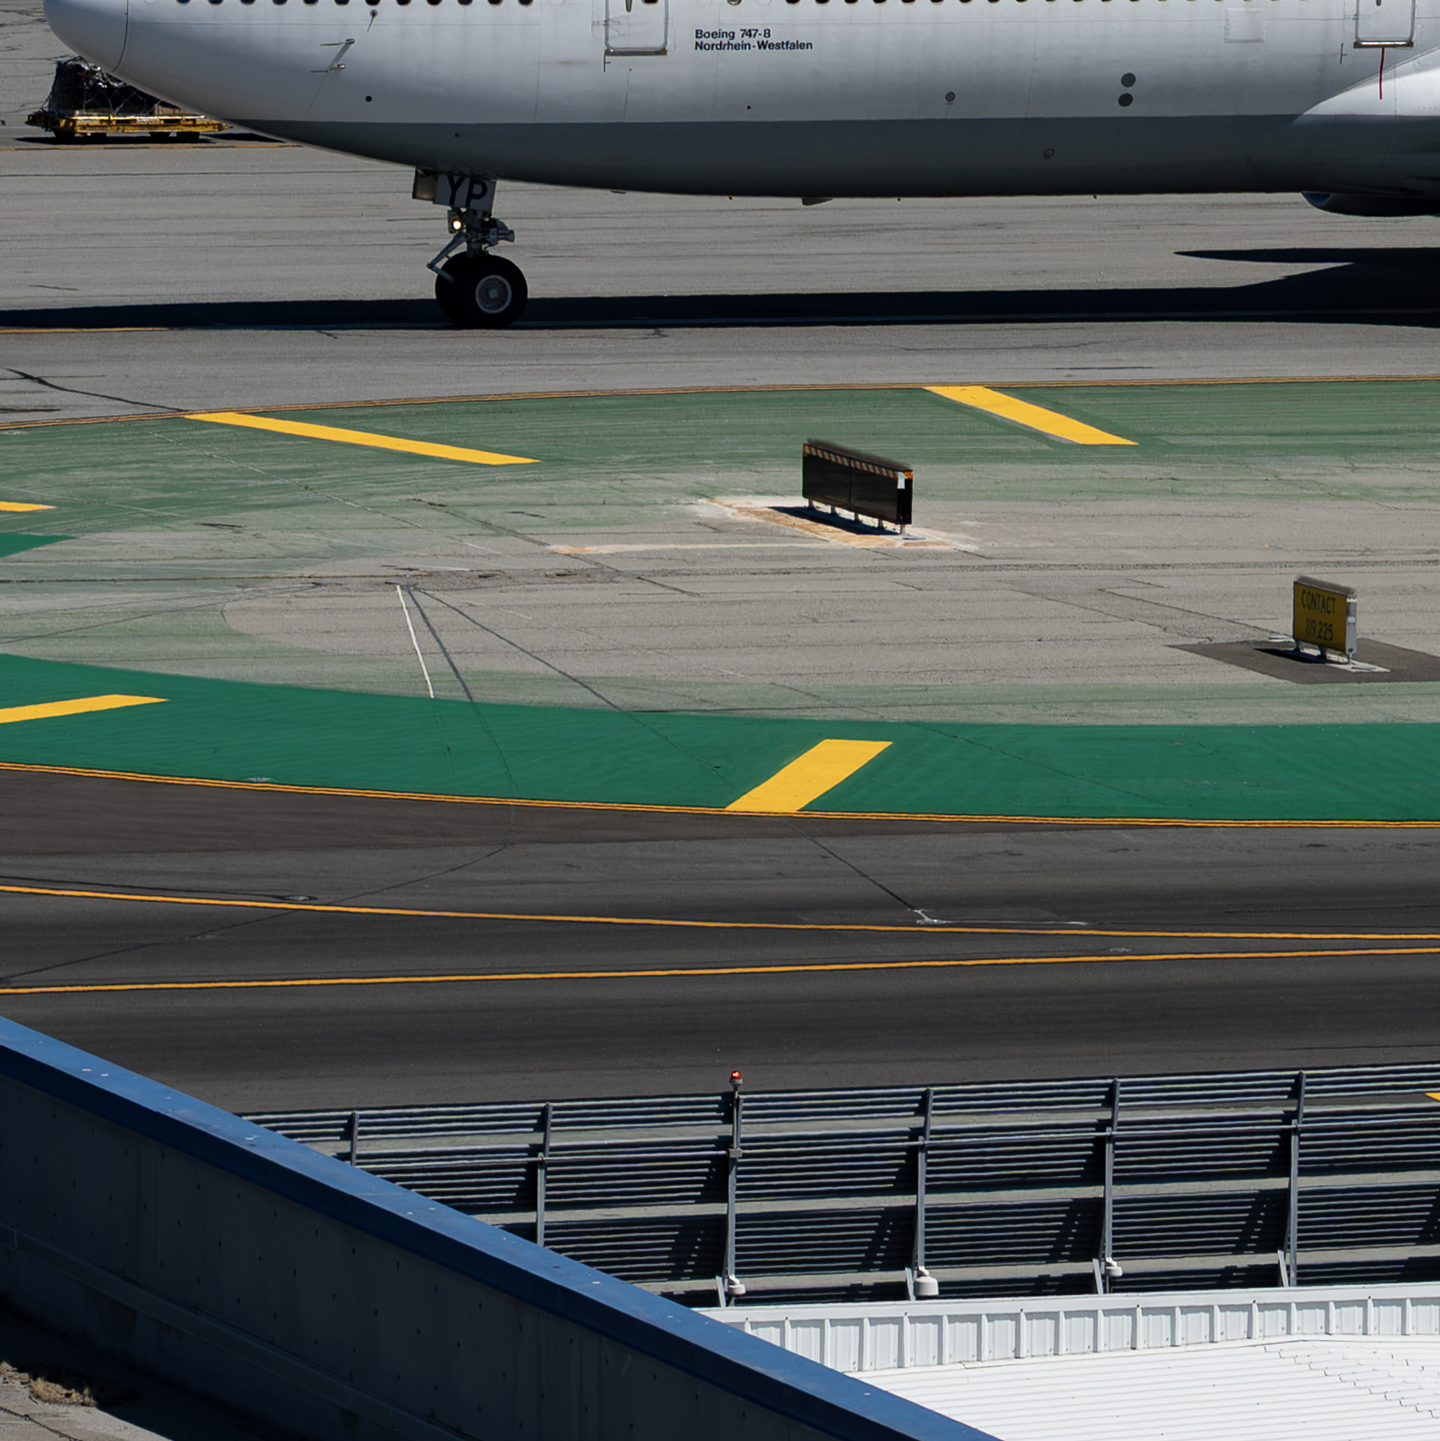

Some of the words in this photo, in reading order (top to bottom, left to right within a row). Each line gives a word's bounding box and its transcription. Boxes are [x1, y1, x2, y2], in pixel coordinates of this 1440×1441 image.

[694, 29, 736, 41] Boeing
[739, 28, 772, 39] 747-8
[694, 40, 814, 51] Nordrhein-Westfalen
[446, 173, 489, 208] YP
[1301, 589, 1336, 616] CONTACT
